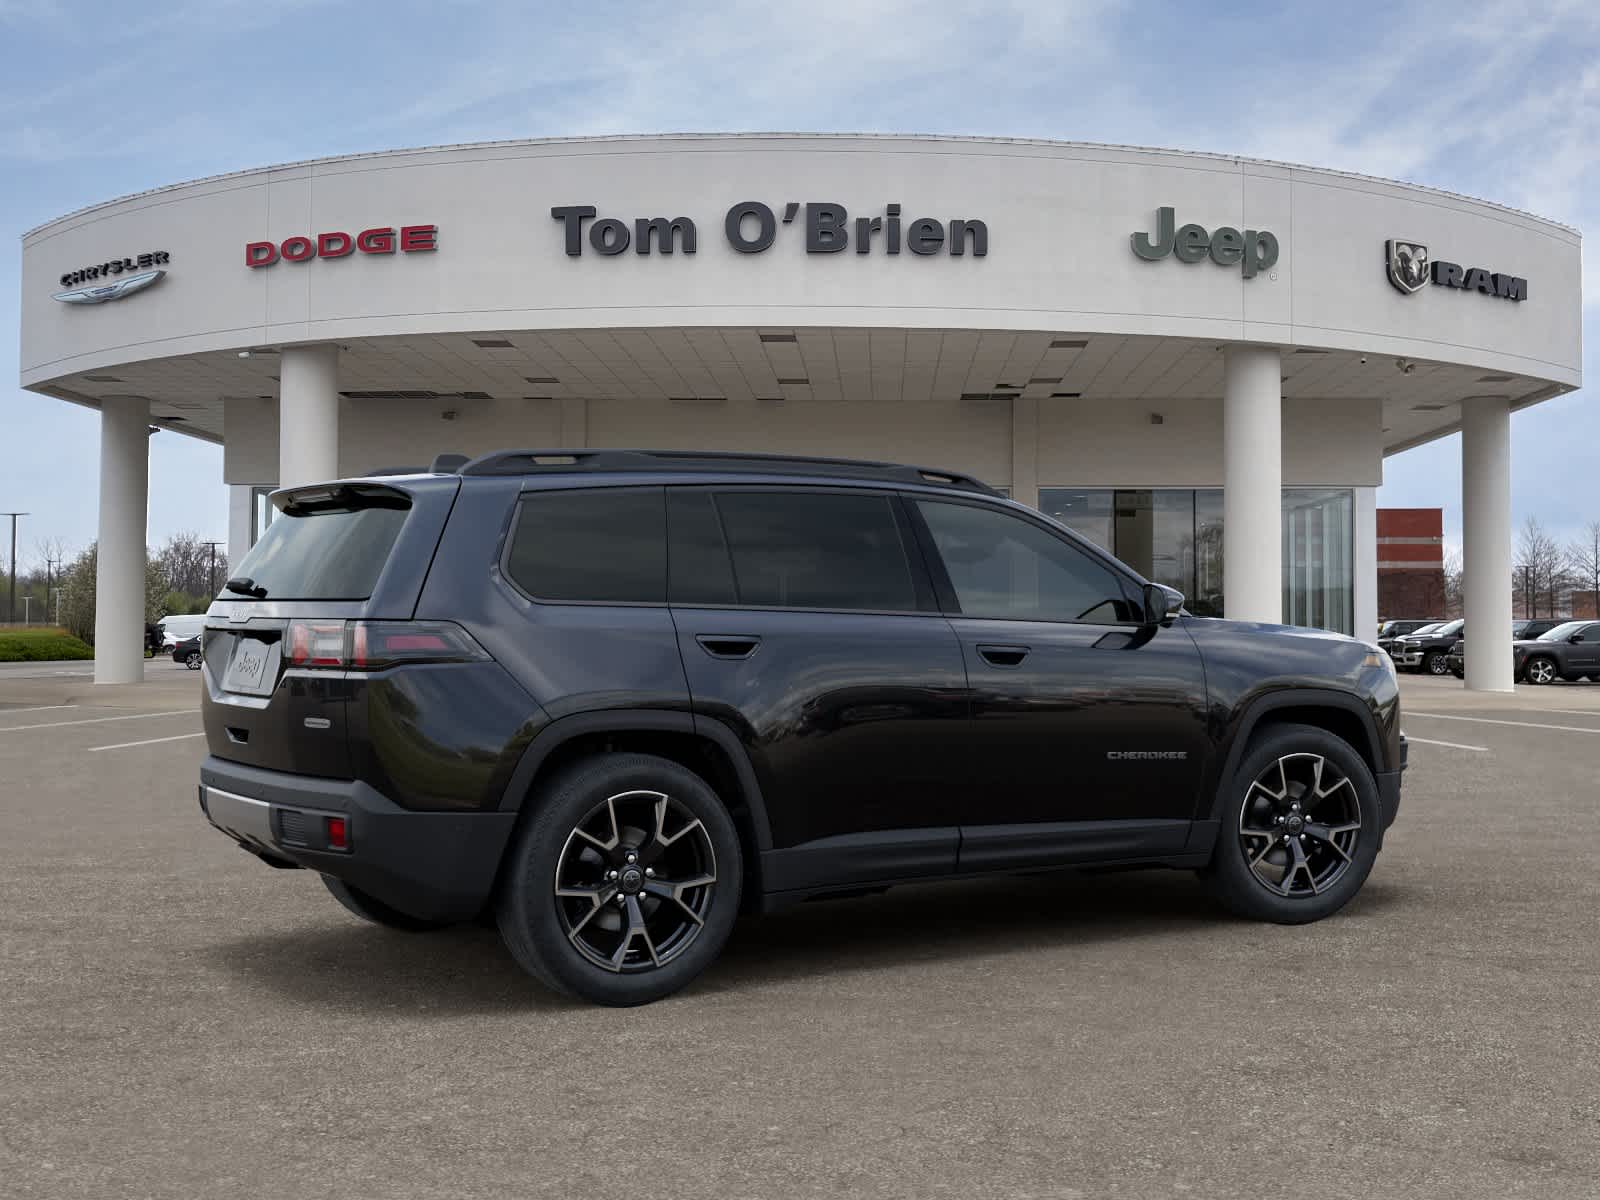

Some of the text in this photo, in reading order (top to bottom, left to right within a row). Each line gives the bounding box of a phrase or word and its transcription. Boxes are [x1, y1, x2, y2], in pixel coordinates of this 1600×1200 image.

[245, 224, 438, 269] DODGE
[551, 201, 988, 257] Tom O'Brien
[1130, 206, 1279, 279] Jeep
[60, 250, 170, 287] CHRYSLER
[1430, 260, 1528, 302] RAM
[1106, 751, 1188, 760] CHEROKEE
